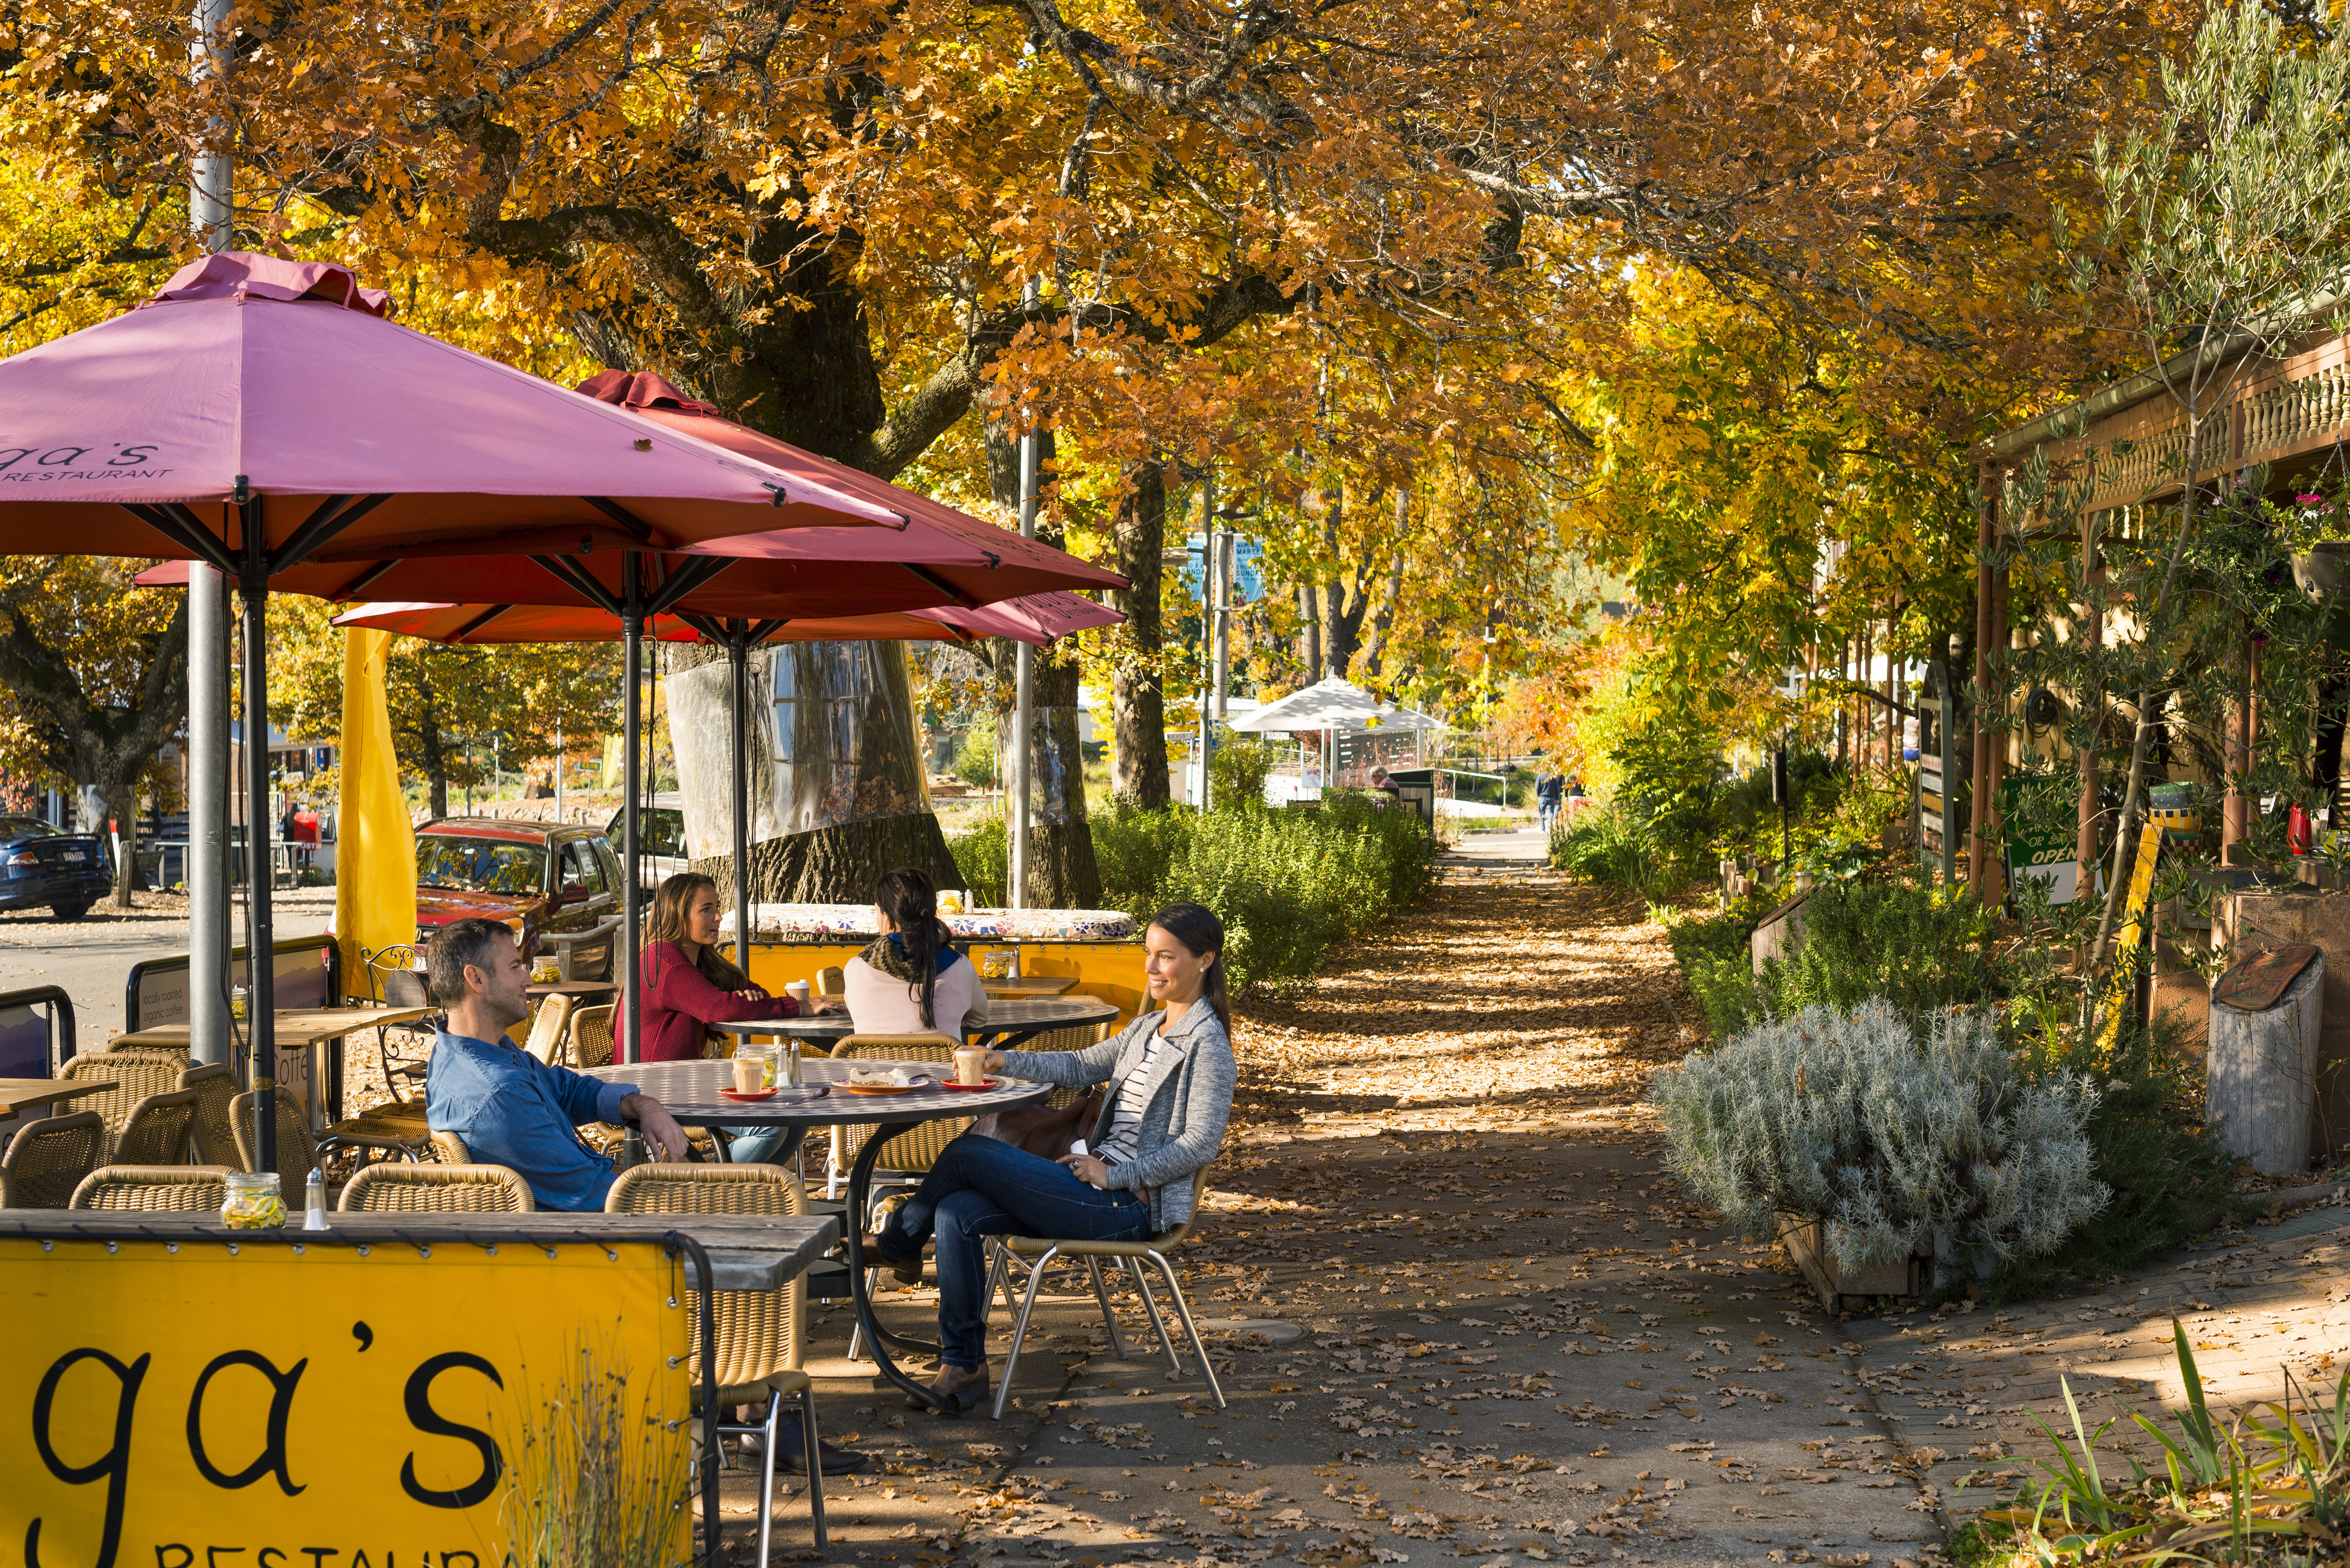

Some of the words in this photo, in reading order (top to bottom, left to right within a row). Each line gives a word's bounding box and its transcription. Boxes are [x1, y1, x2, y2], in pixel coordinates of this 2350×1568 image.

[1, 469, 174, 482] RESTAURANT
[2031, 847, 2078, 864] OPEN
[143, 991, 161, 1005] locally
[162, 987, 182, 1001] roasted
[144, 1007, 164, 1023] organic
[165, 1004, 183, 1017] coffee
[24, 1320, 504, 1568] ga's
